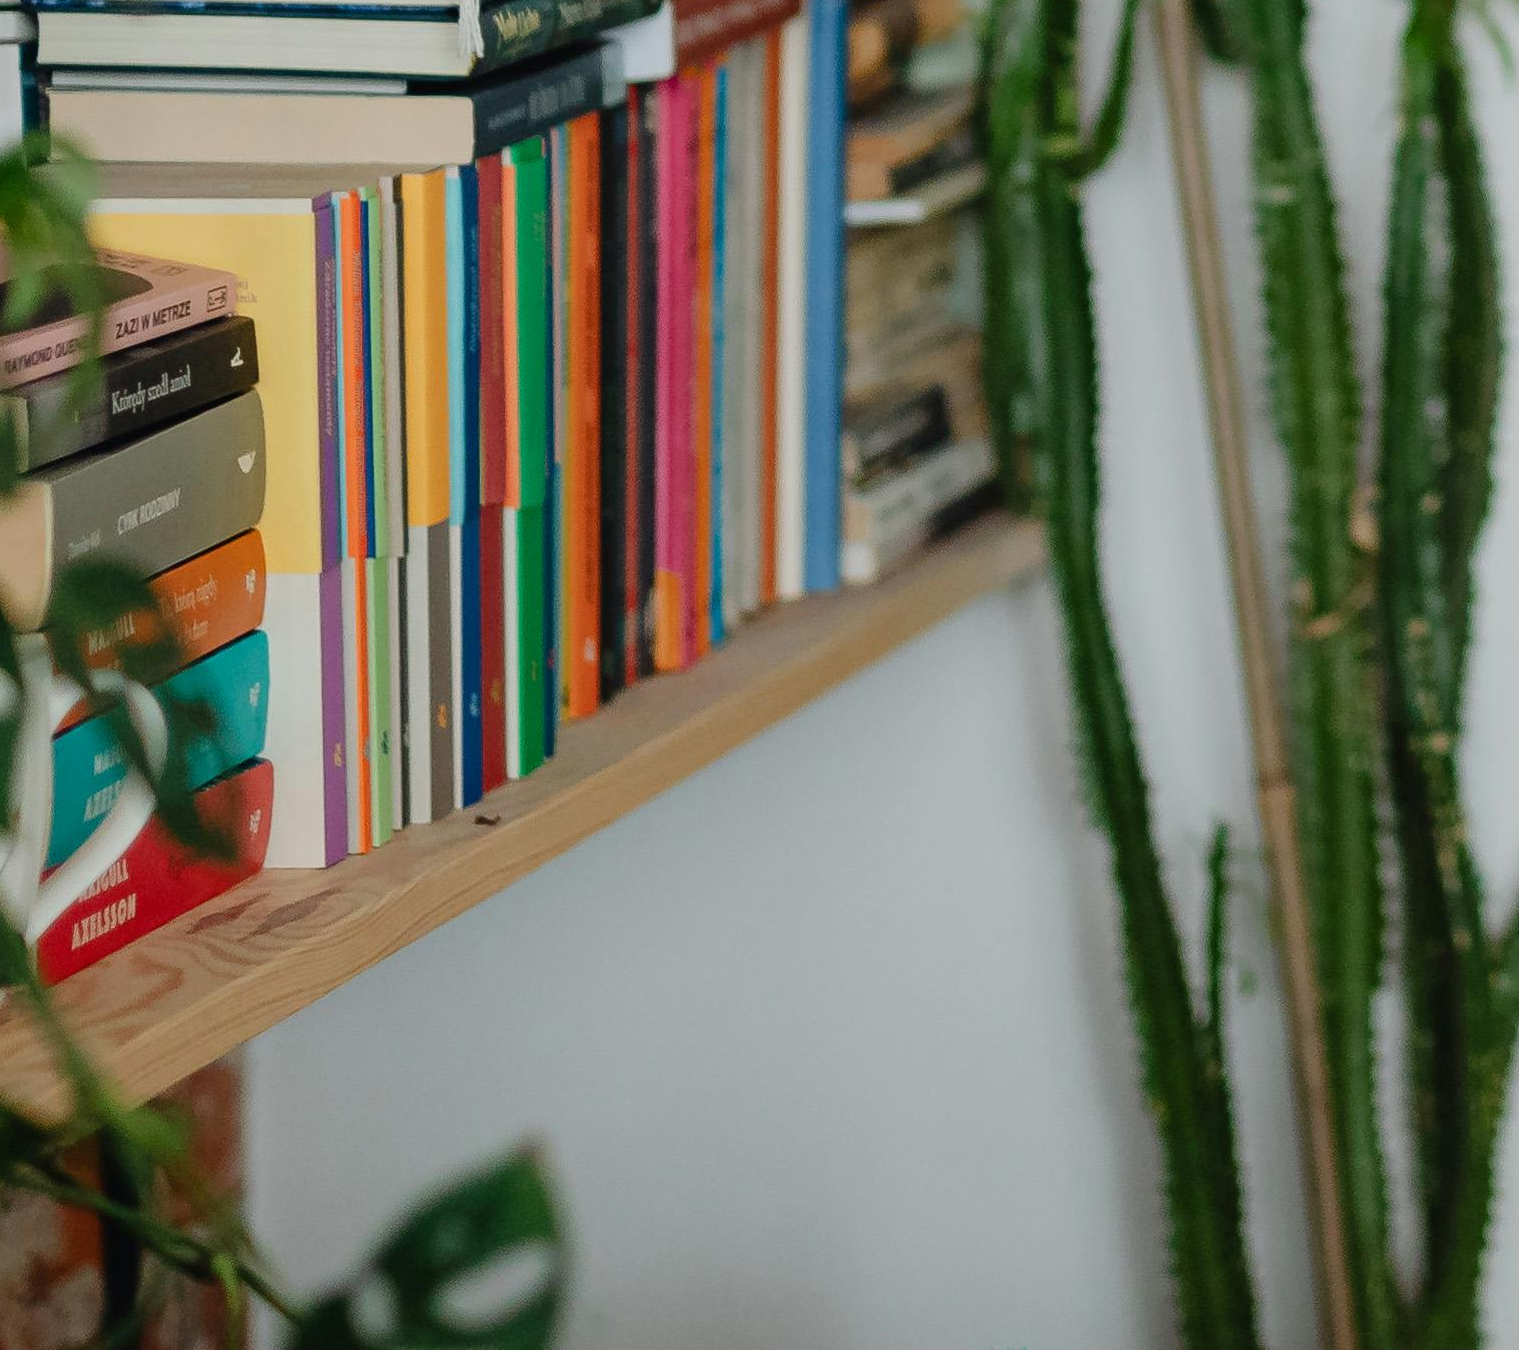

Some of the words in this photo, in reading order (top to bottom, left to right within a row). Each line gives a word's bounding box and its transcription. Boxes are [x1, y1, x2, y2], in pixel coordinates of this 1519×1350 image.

[115, 317, 140, 340] ZAZI
[141, 313, 151, 333] W
[152, 300, 192, 328] METRZE
[110, 380, 147, 416] Którędy
[117, 507, 139, 536] CYRK
[139, 486, 182, 525] RODZINNY
[71, 892, 138, 951] AXELSSON
